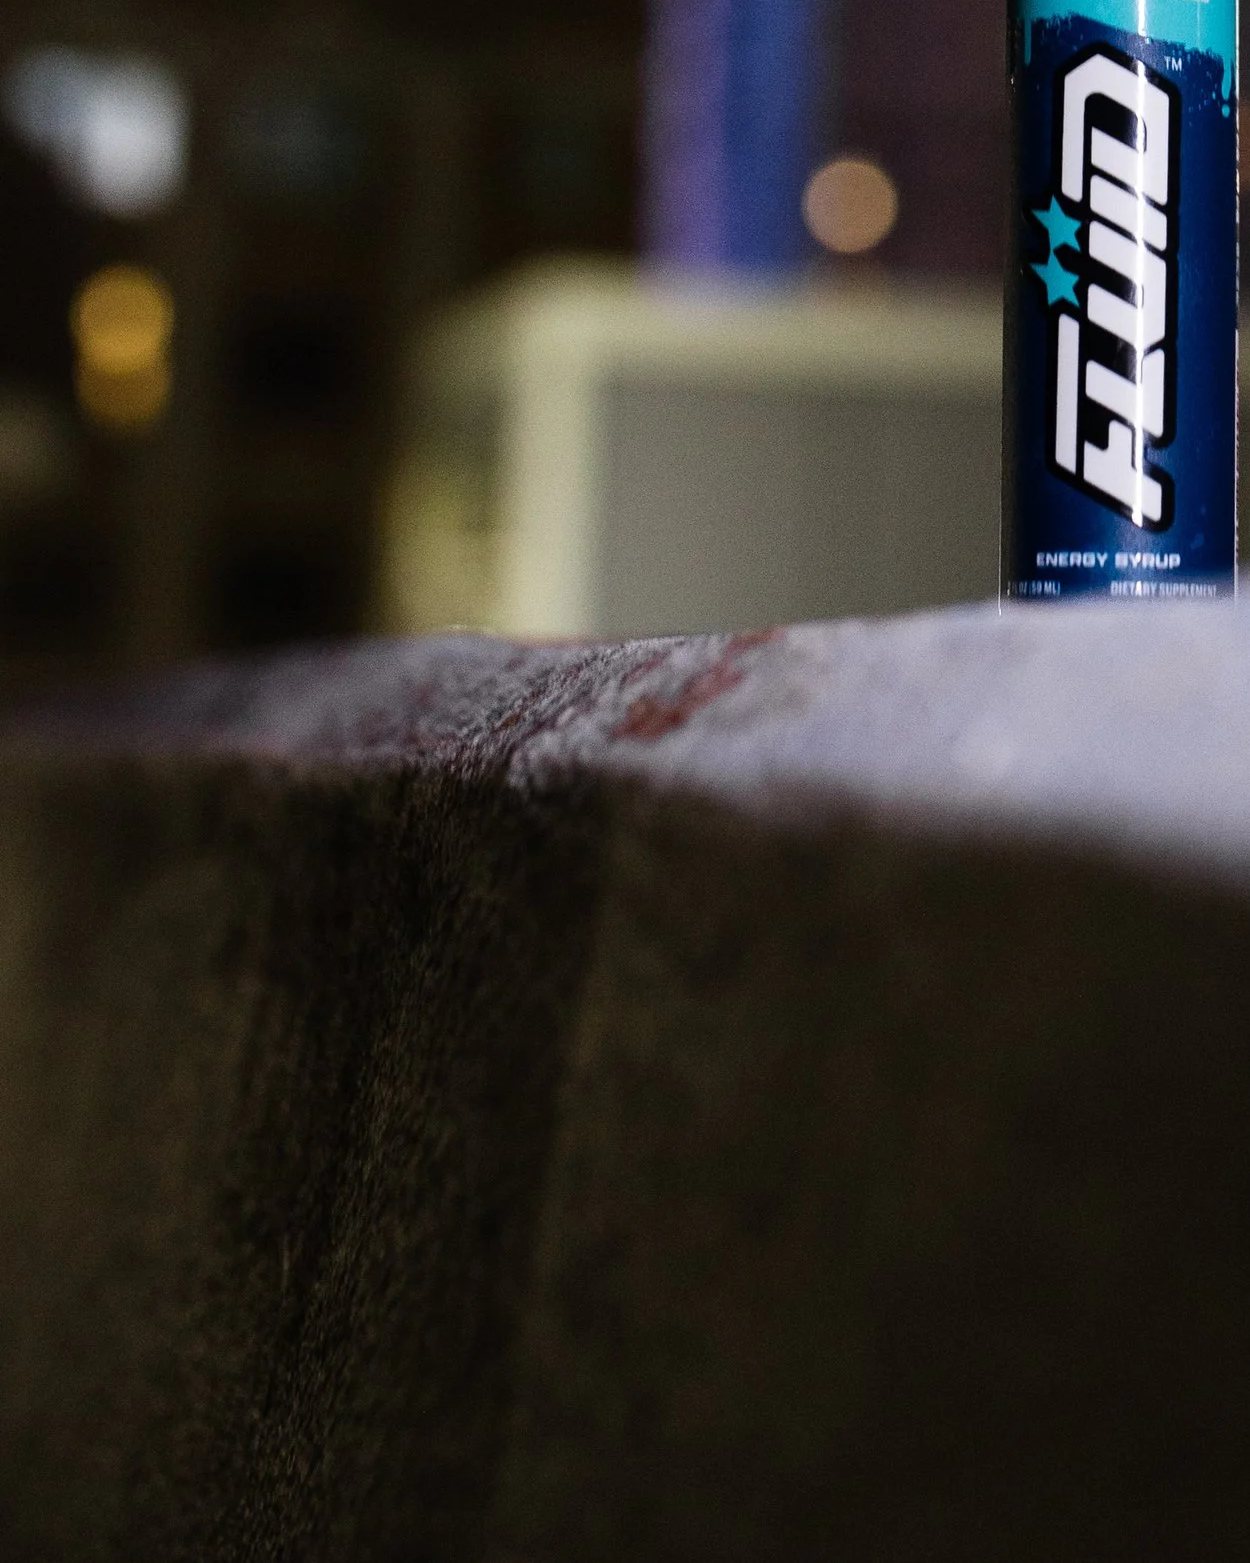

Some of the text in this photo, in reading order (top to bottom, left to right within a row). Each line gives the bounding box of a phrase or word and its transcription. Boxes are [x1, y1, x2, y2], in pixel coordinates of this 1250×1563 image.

[1053, 52, 1172, 528] FLUID
[1036, 551, 1181, 569] ENERGY SYRUP
[1110, 580, 1217, 598] DIETARY SUPPLEMENT
